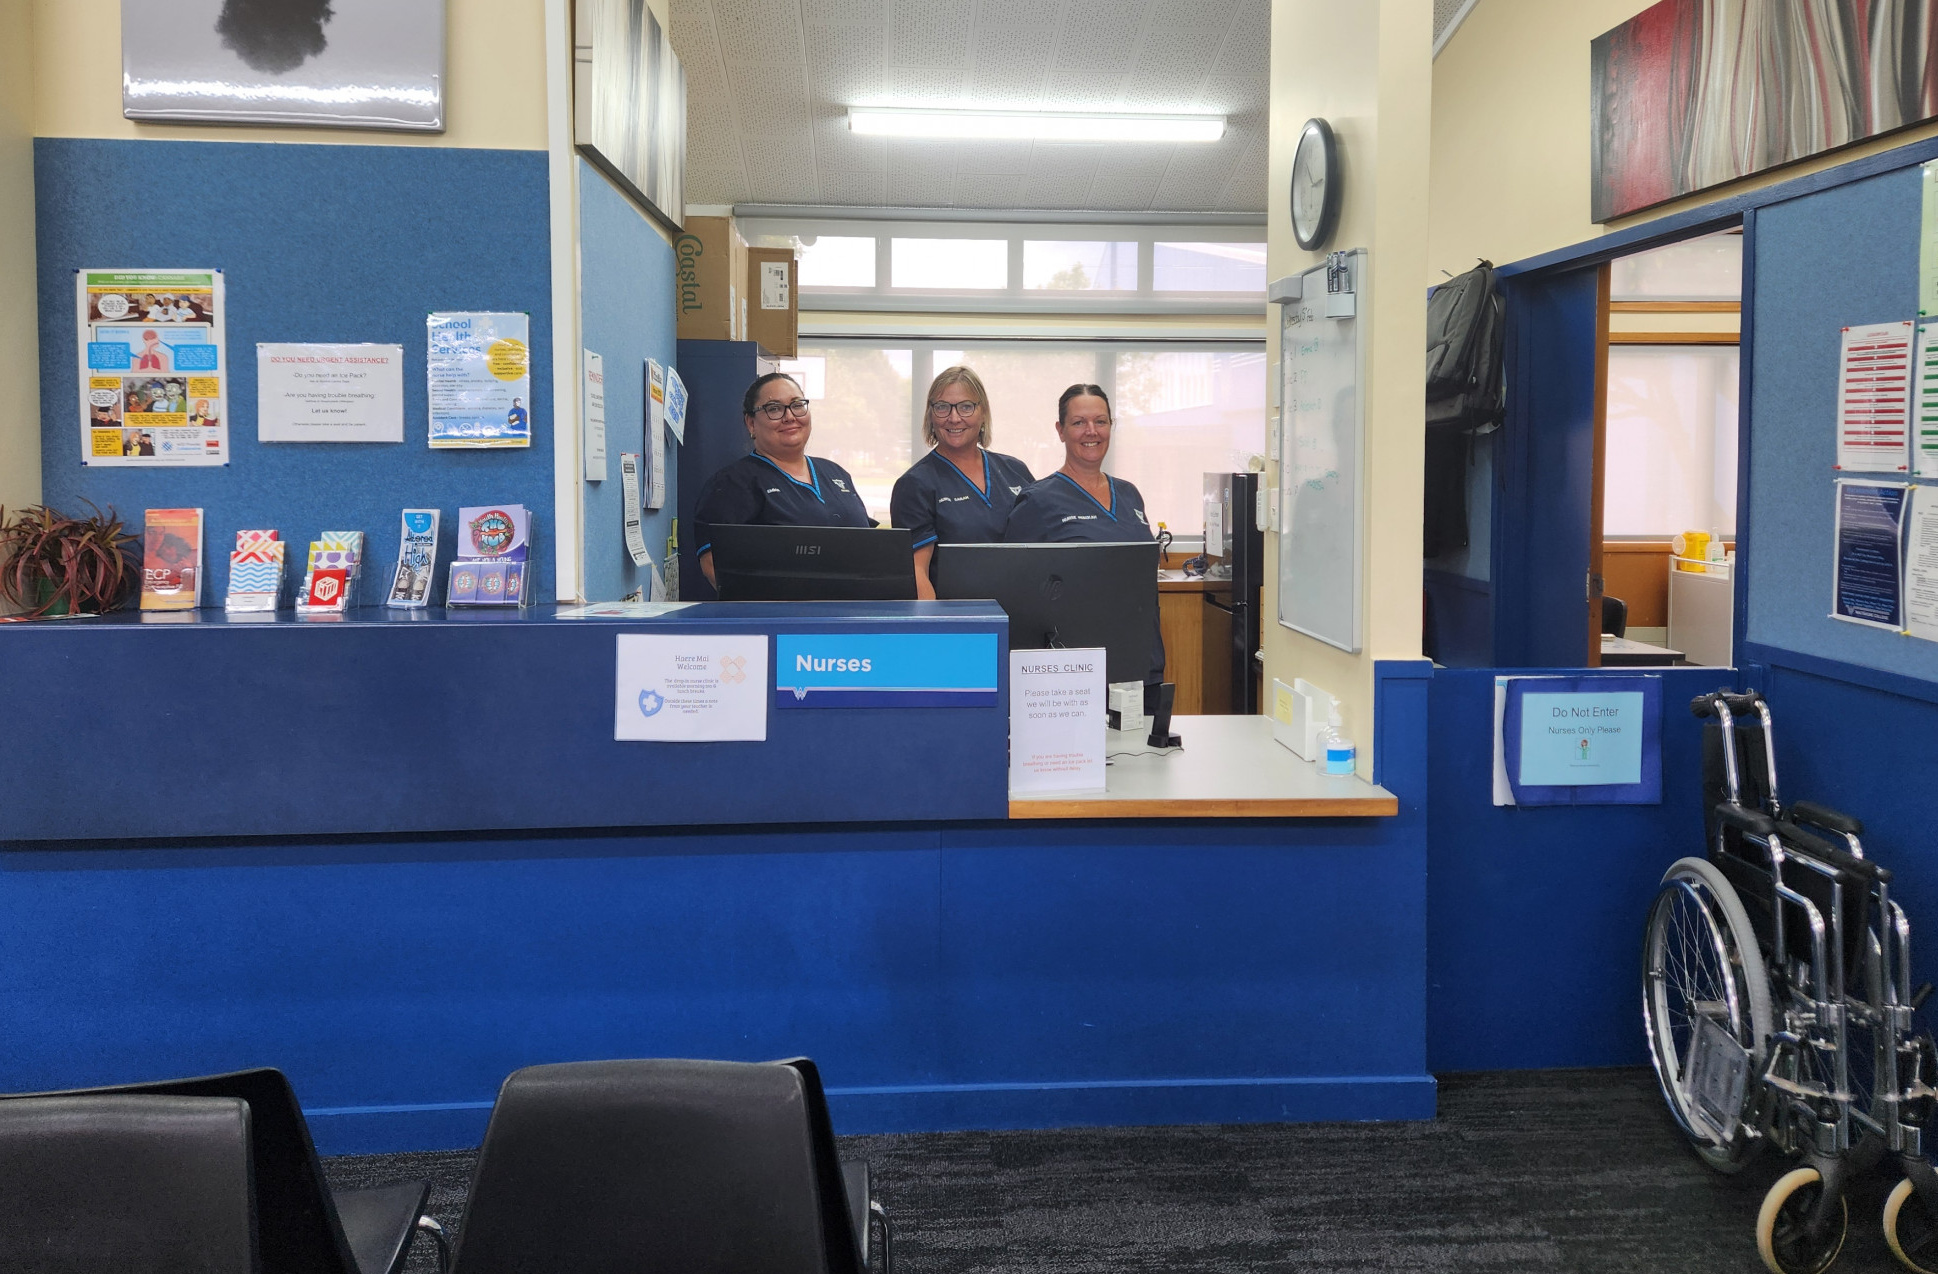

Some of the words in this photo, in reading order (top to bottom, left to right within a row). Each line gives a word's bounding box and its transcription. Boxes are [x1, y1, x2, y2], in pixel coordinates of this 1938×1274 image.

[675, 234, 703, 314] Coastal
[404, 545, 428, 572] High
[145, 569, 171, 579] ECP
[796, 654, 872, 672] Nurses
[1022, 665, 1059, 674] NURSES
[1064, 664, 1093, 672] CLINIC
[1552, 707, 1568, 717] Do
[1572, 707, 1590, 717] Not
[1593, 707, 1619, 717] Enter
[1578, 726, 1595, 736] Only
